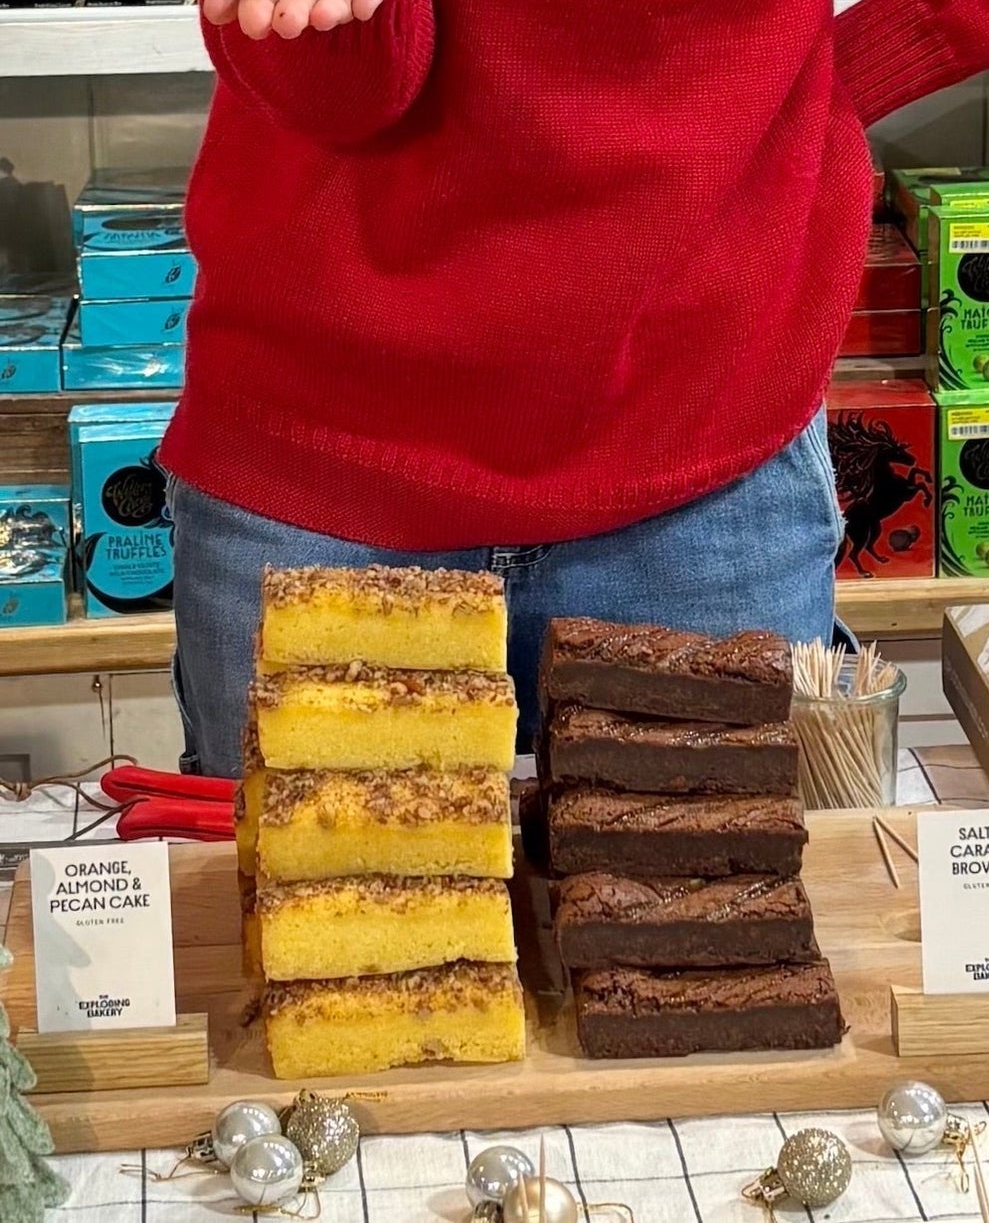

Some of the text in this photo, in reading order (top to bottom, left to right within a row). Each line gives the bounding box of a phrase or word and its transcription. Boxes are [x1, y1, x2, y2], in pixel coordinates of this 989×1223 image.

[108, 533, 163, 548] PRALINE
[107, 545, 167, 560] TRUFFLES
[65, 861, 132, 877] ORANGE,
[56, 877, 142, 895] ALMOND &
[50, 894, 150, 913] PECAN CAKE
[79, 998, 130, 1010] EXPLODING
[87, 1008, 123, 1018] BAKERY
